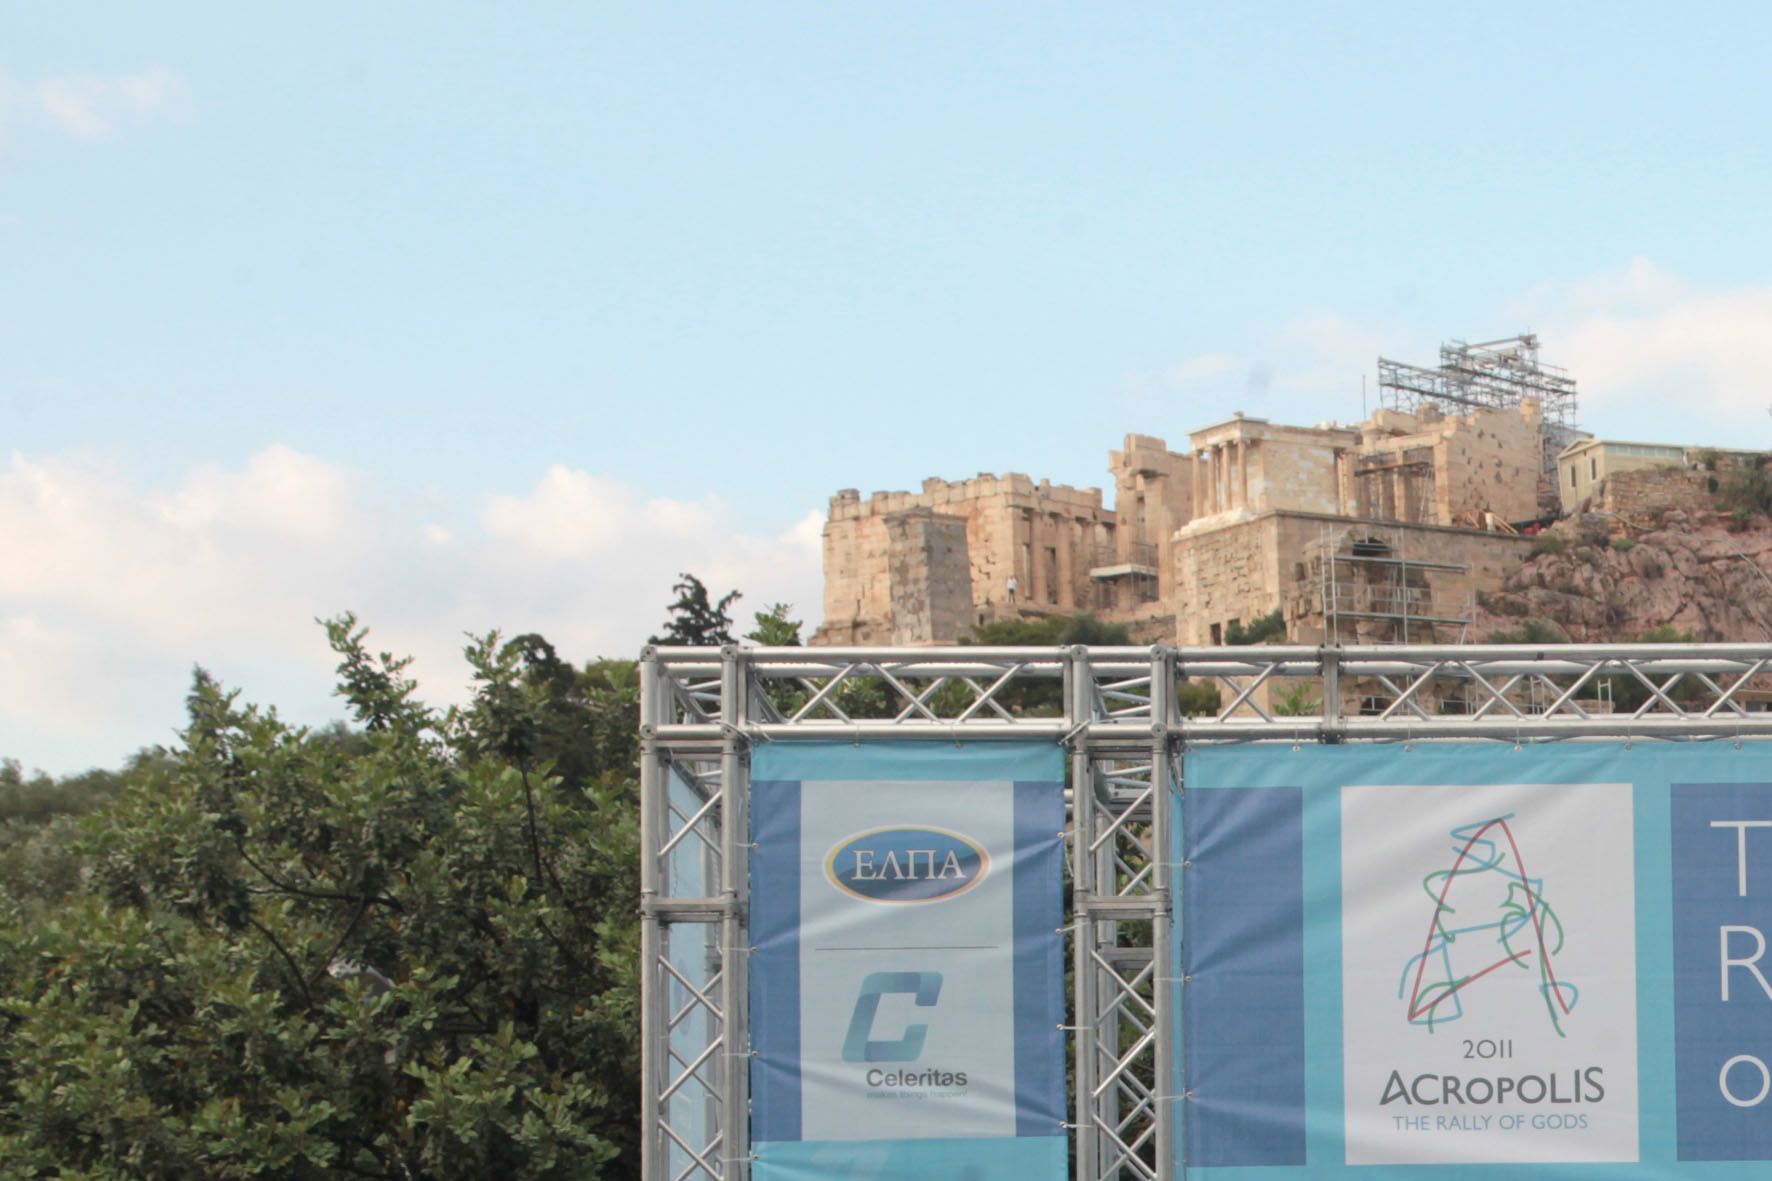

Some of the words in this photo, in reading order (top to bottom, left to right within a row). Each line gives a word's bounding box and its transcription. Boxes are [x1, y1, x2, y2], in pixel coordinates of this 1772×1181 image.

[1462, 1039, 1513, 1059] 2011
[866, 1068, 968, 1087] Celeritas
[1379, 1066, 1605, 1106] ACROPOLIS
[1392, 1115, 1430, 1131] THE
[1436, 1114, 1493, 1131] RALLY
[1499, 1114, 1526, 1130] OF
[1531, 1113, 1589, 1130] GODS
